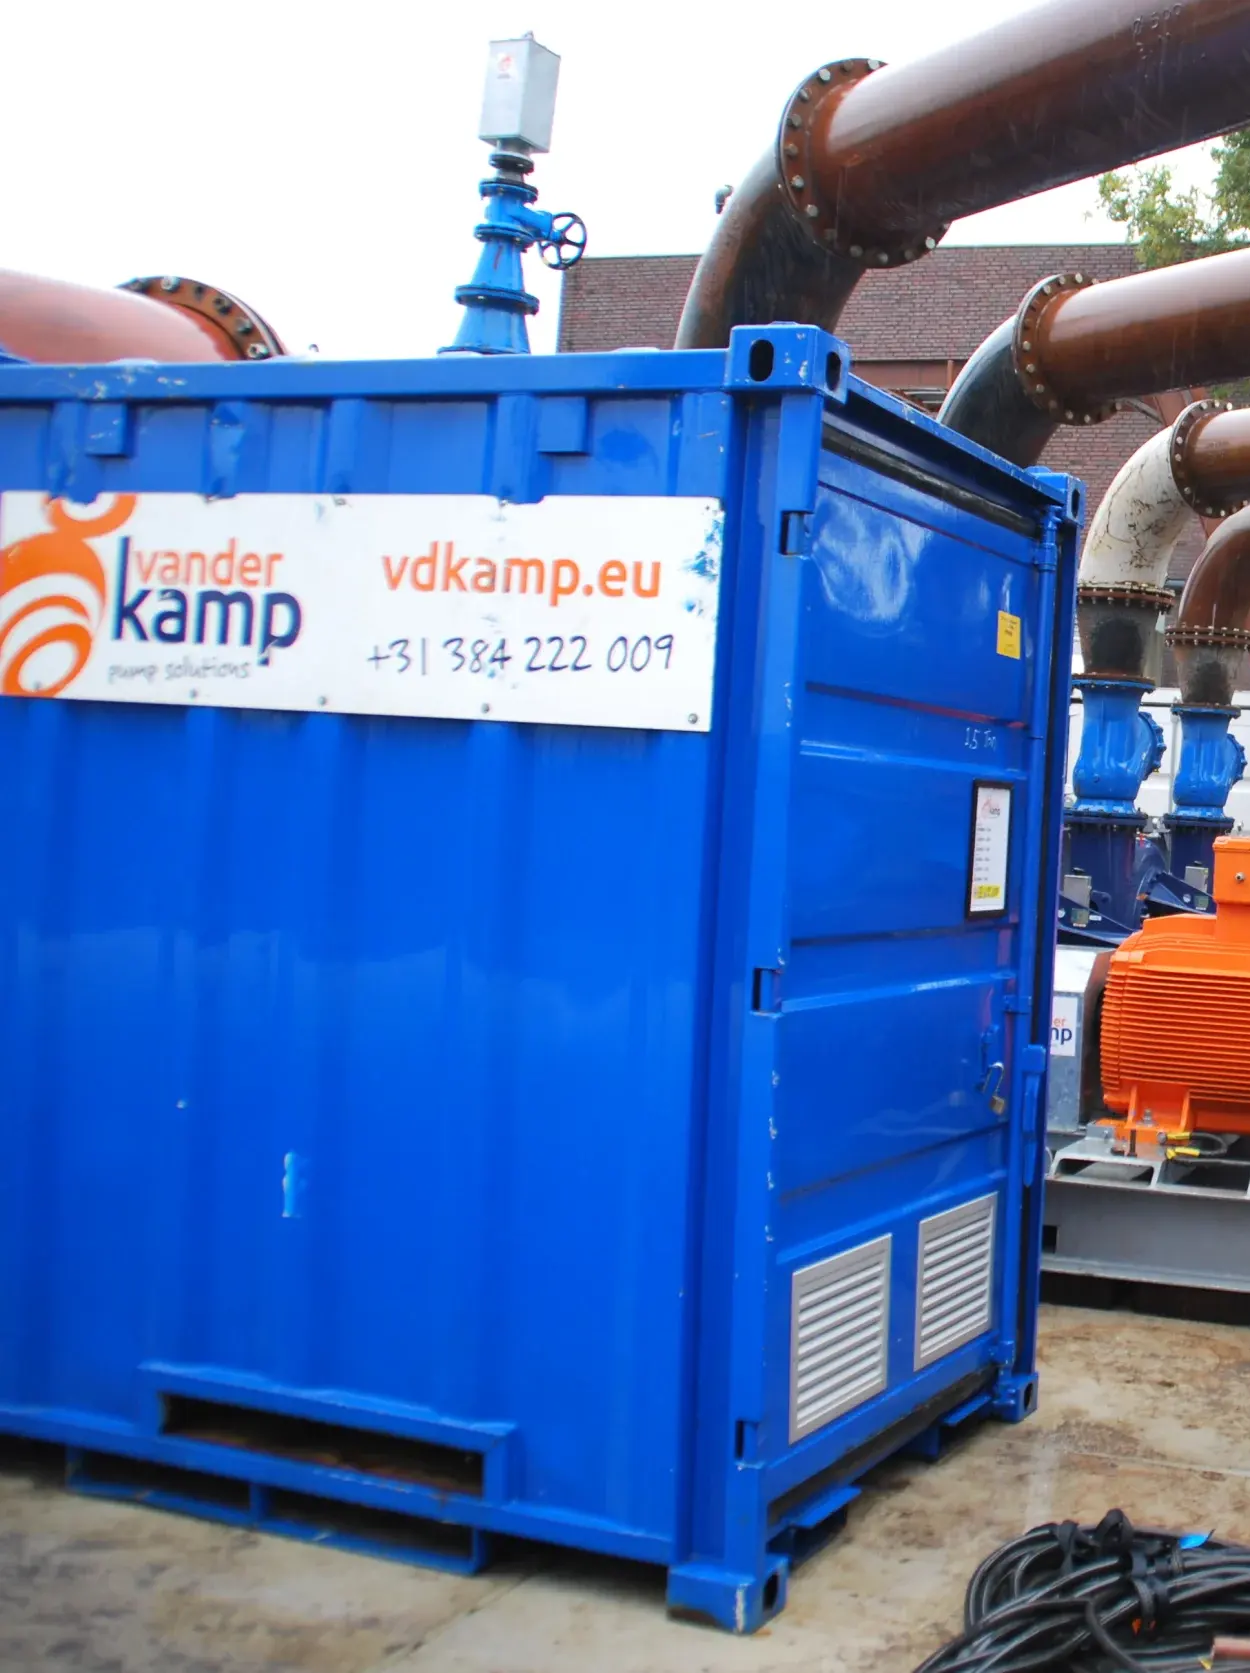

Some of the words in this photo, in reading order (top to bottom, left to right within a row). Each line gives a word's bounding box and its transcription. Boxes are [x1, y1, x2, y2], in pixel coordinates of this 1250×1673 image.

[136, 537, 284, 586] vander
[381, 540, 662, 607] vdkamp.eu
[110, 535, 303, 667] kamp
[107, 662, 159, 684] pump
[164, 656, 253, 681] solutions
[367, 637, 427, 677] +31
[442, 636, 512, 674] 384
[523, 634, 593, 673] 222
[606, 633, 675, 674] 009
